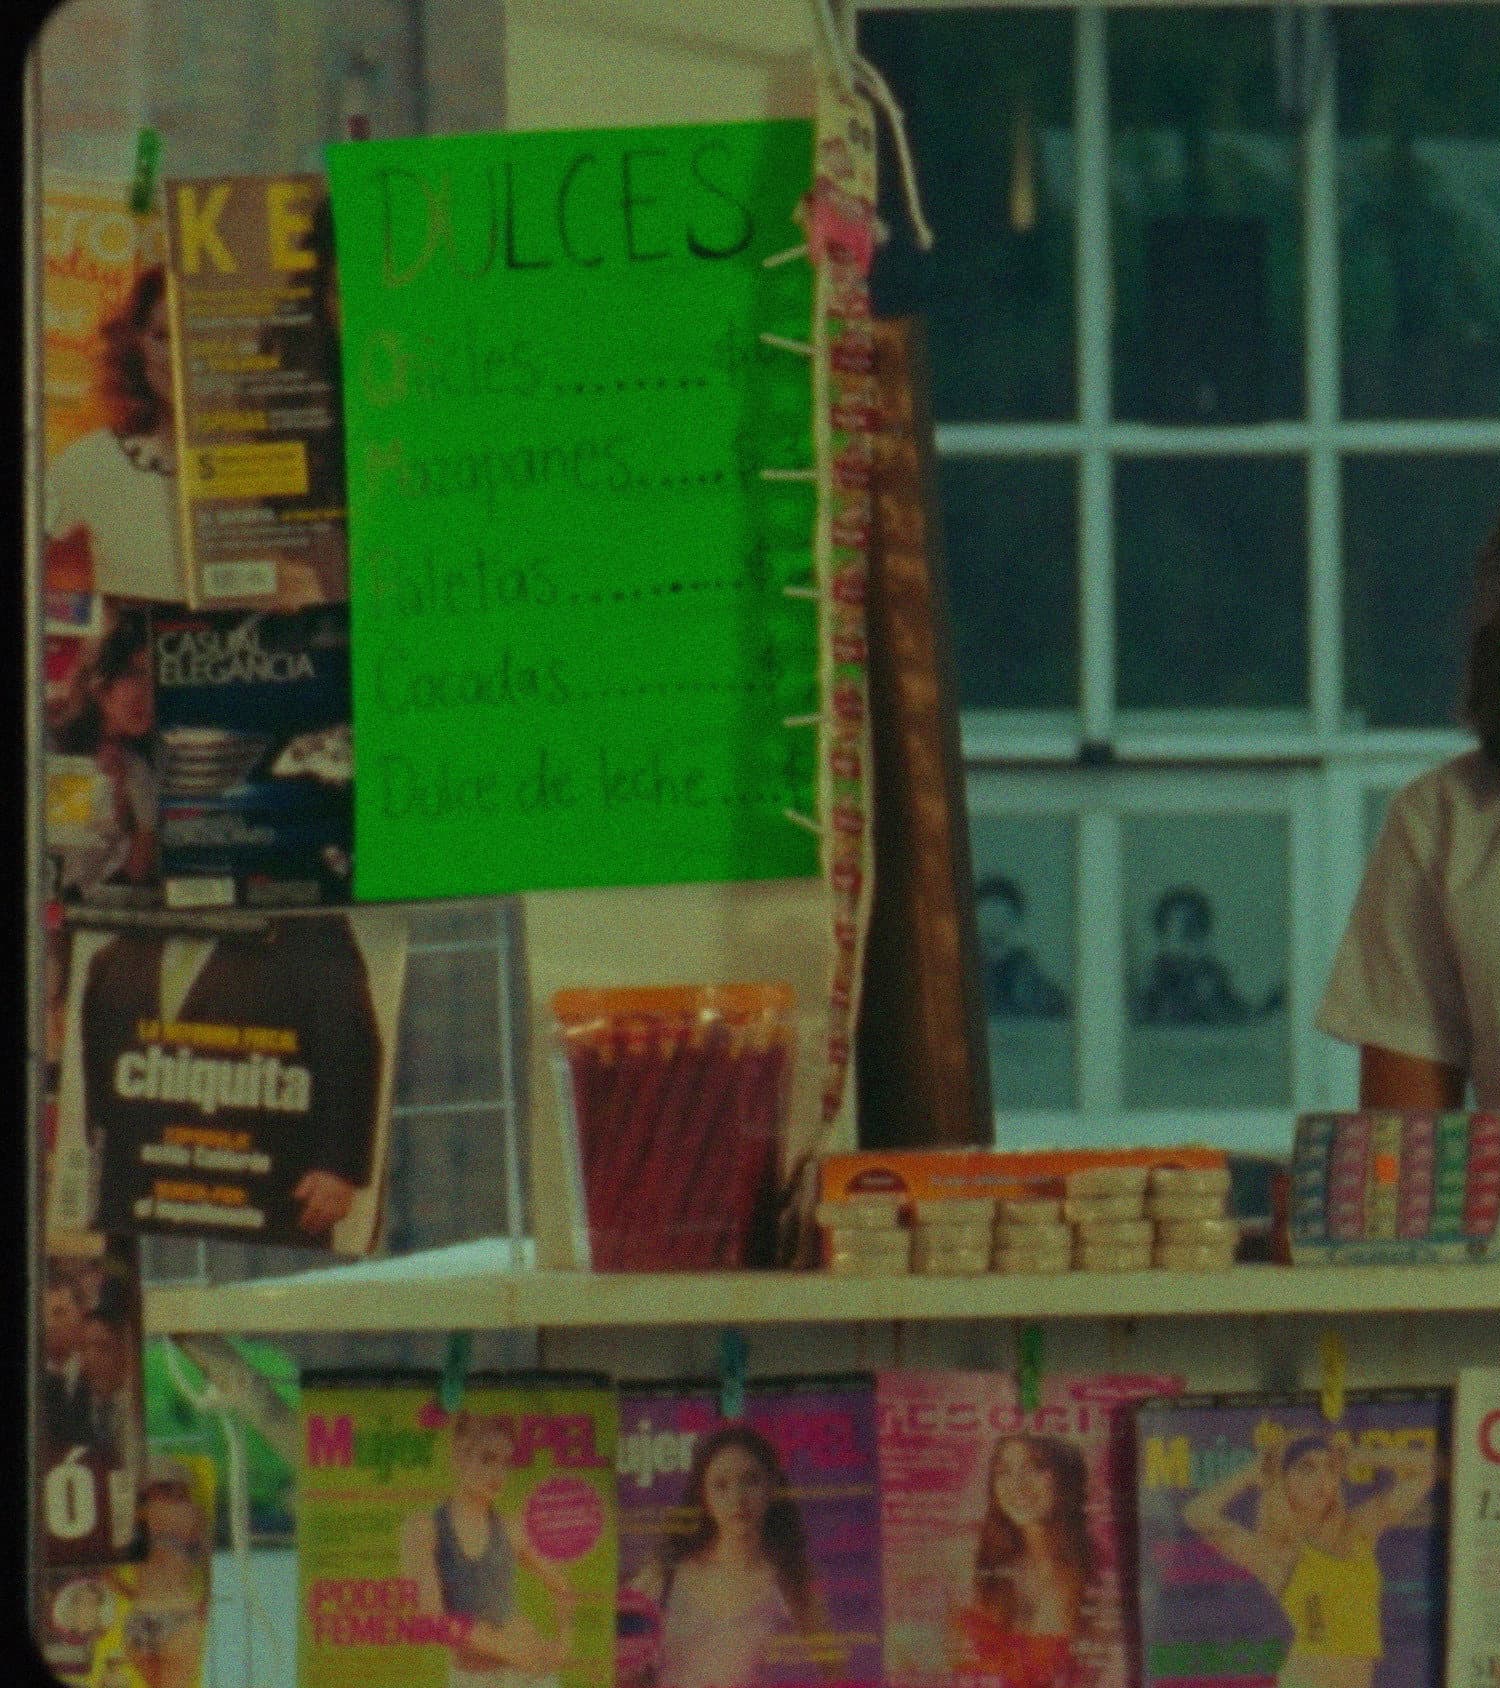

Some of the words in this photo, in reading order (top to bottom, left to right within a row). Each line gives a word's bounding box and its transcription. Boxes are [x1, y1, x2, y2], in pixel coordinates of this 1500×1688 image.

[375, 140, 757, 289] DULCES
[363, 434, 633, 516] Mazapanes
[368, 546, 558, 617] Paletas
[159, 651, 317, 687] ELEGANCIA
[375, 646, 574, 714] Cocadas
[377, 753, 499, 819] Dulce
[516, 747, 576, 809] de
[597, 746, 710, 811] leche
[115, 1045, 312, 1115] chiquita
[615, 1417, 699, 1488] ujer
[310, 1578, 419, 1614] PODER
[313, 1613, 474, 1648] FEMENINO
